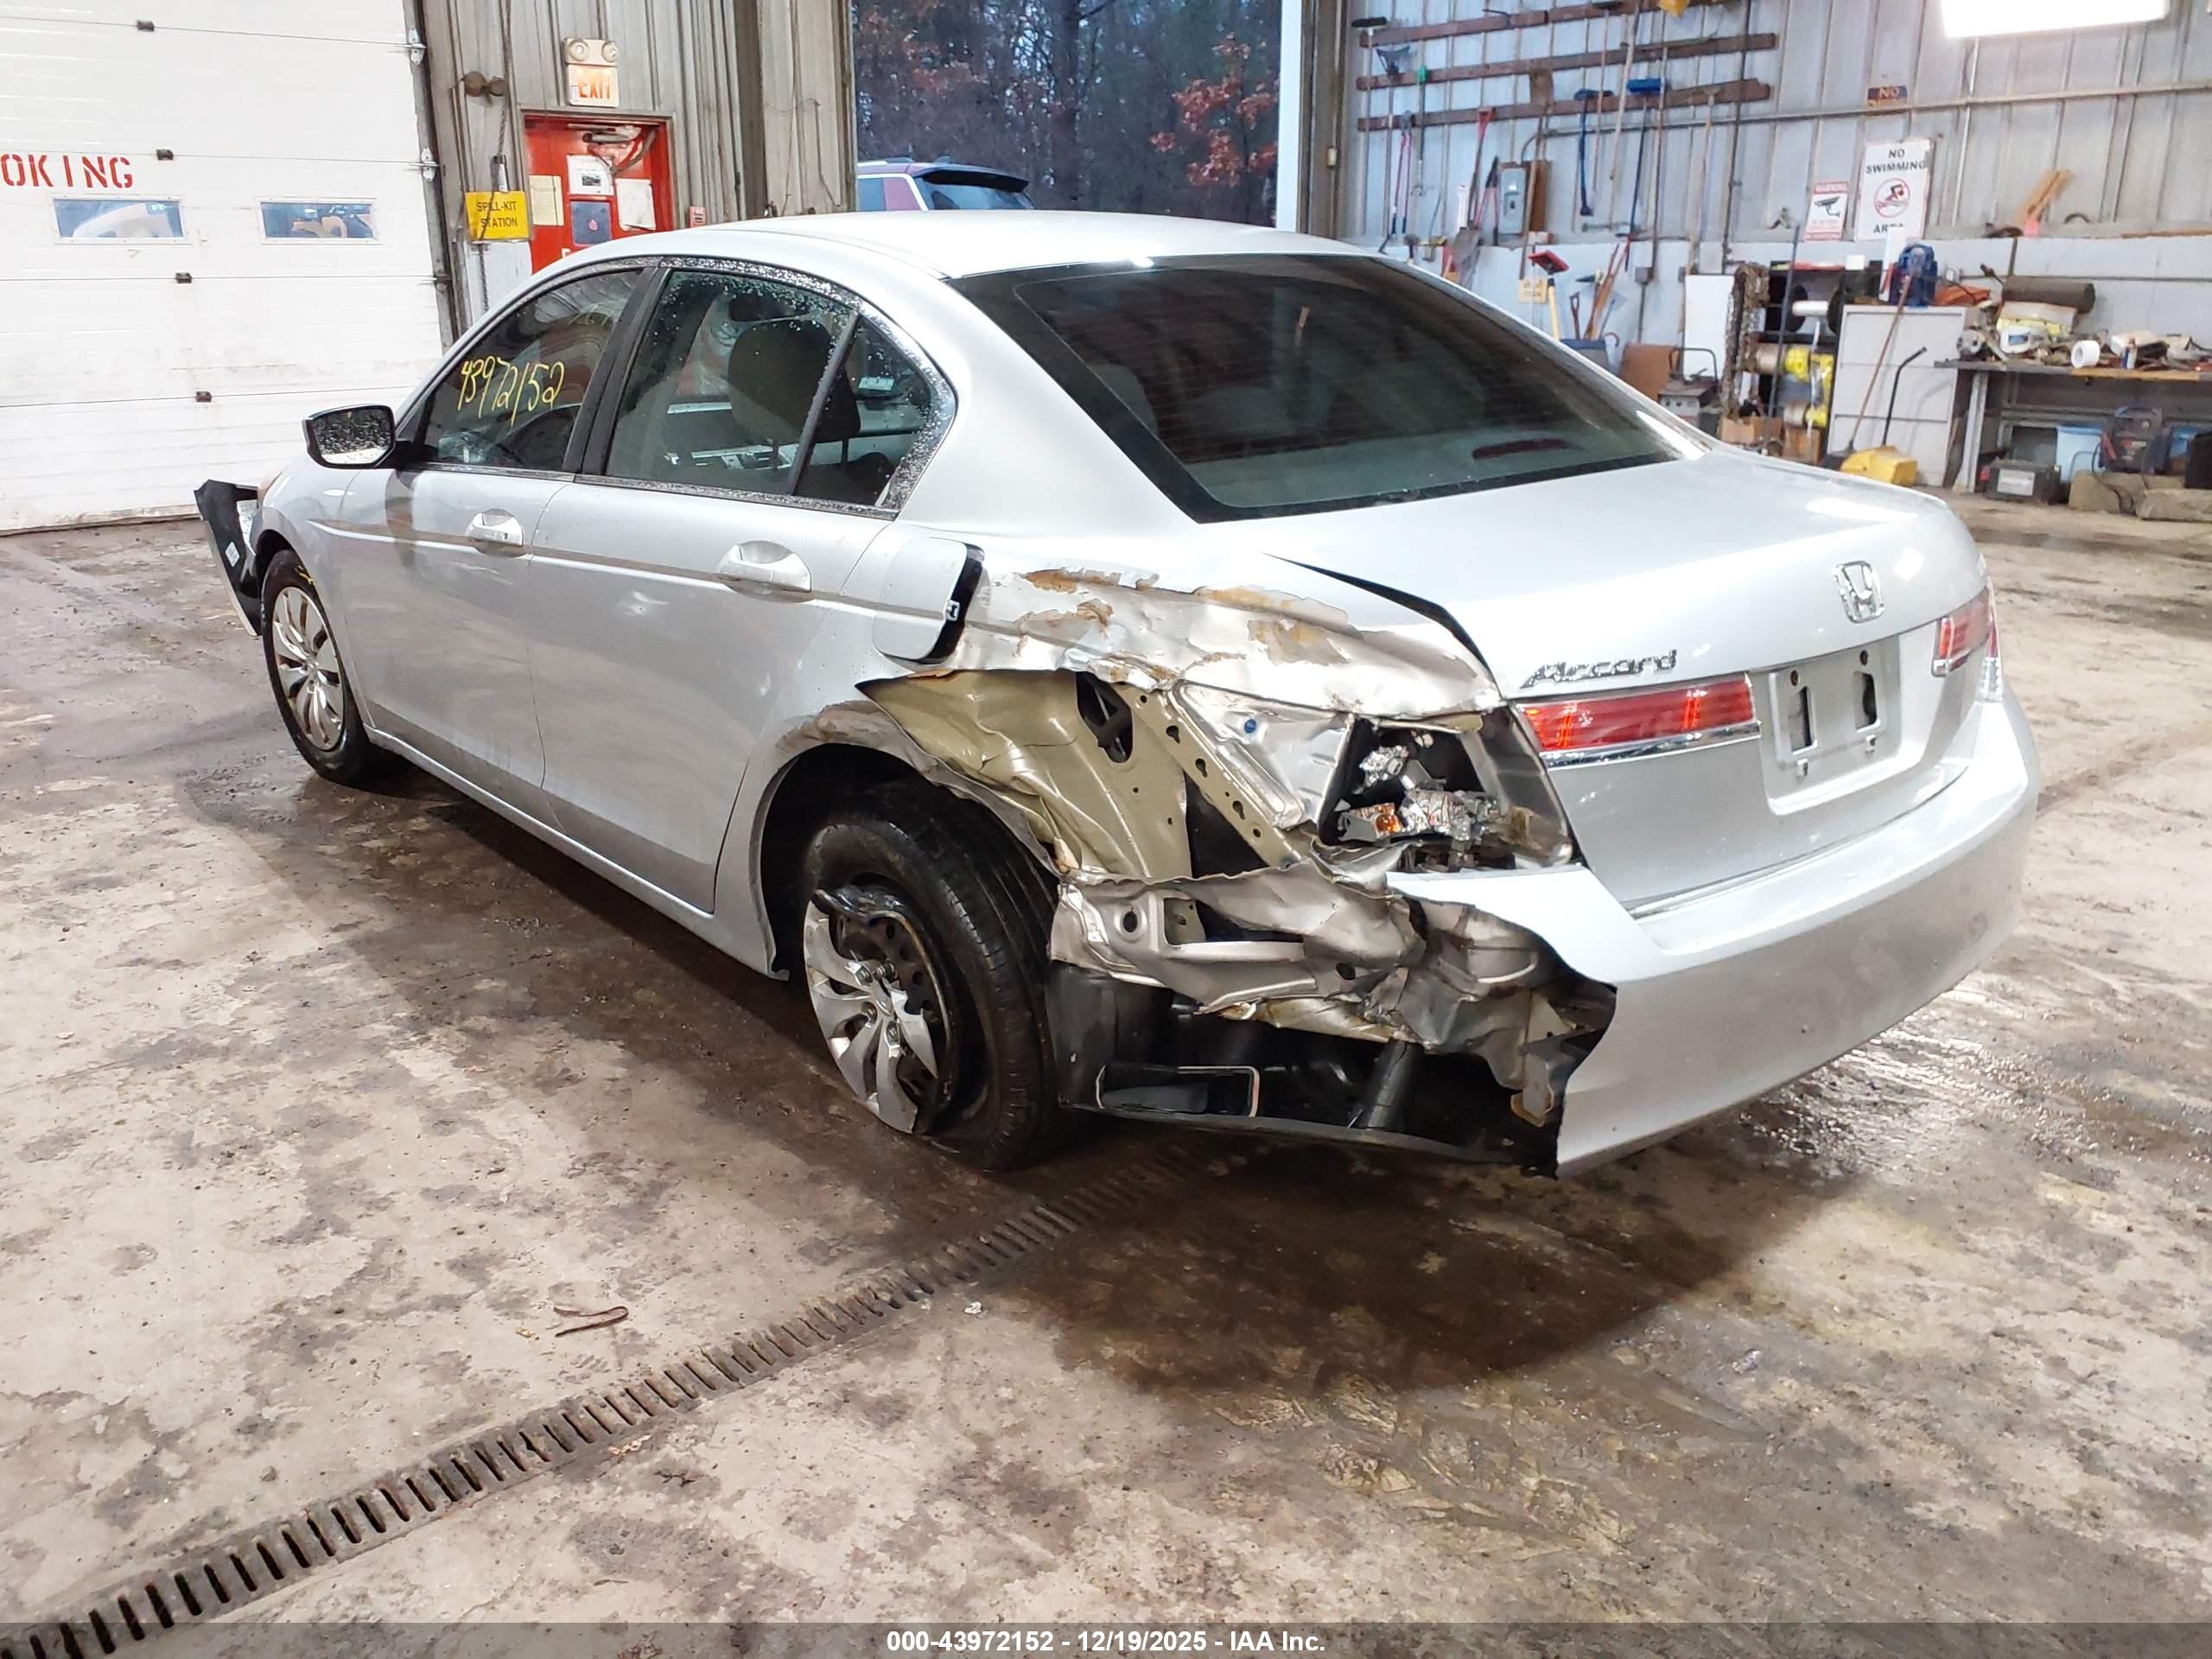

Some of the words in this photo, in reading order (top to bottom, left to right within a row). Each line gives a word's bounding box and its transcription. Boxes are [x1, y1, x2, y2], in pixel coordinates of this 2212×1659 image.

[1889, 149, 1905, 159] NO
[0, 154, 134, 188] OKING
[1866, 160, 1927, 174] SWIMMING
[476, 200, 518, 212] SPLL-KIT
[1872, 223, 1904, 233] AR
[457, 355, 566, 429] 43972152
[1519, 649, 1677, 690] Accord
